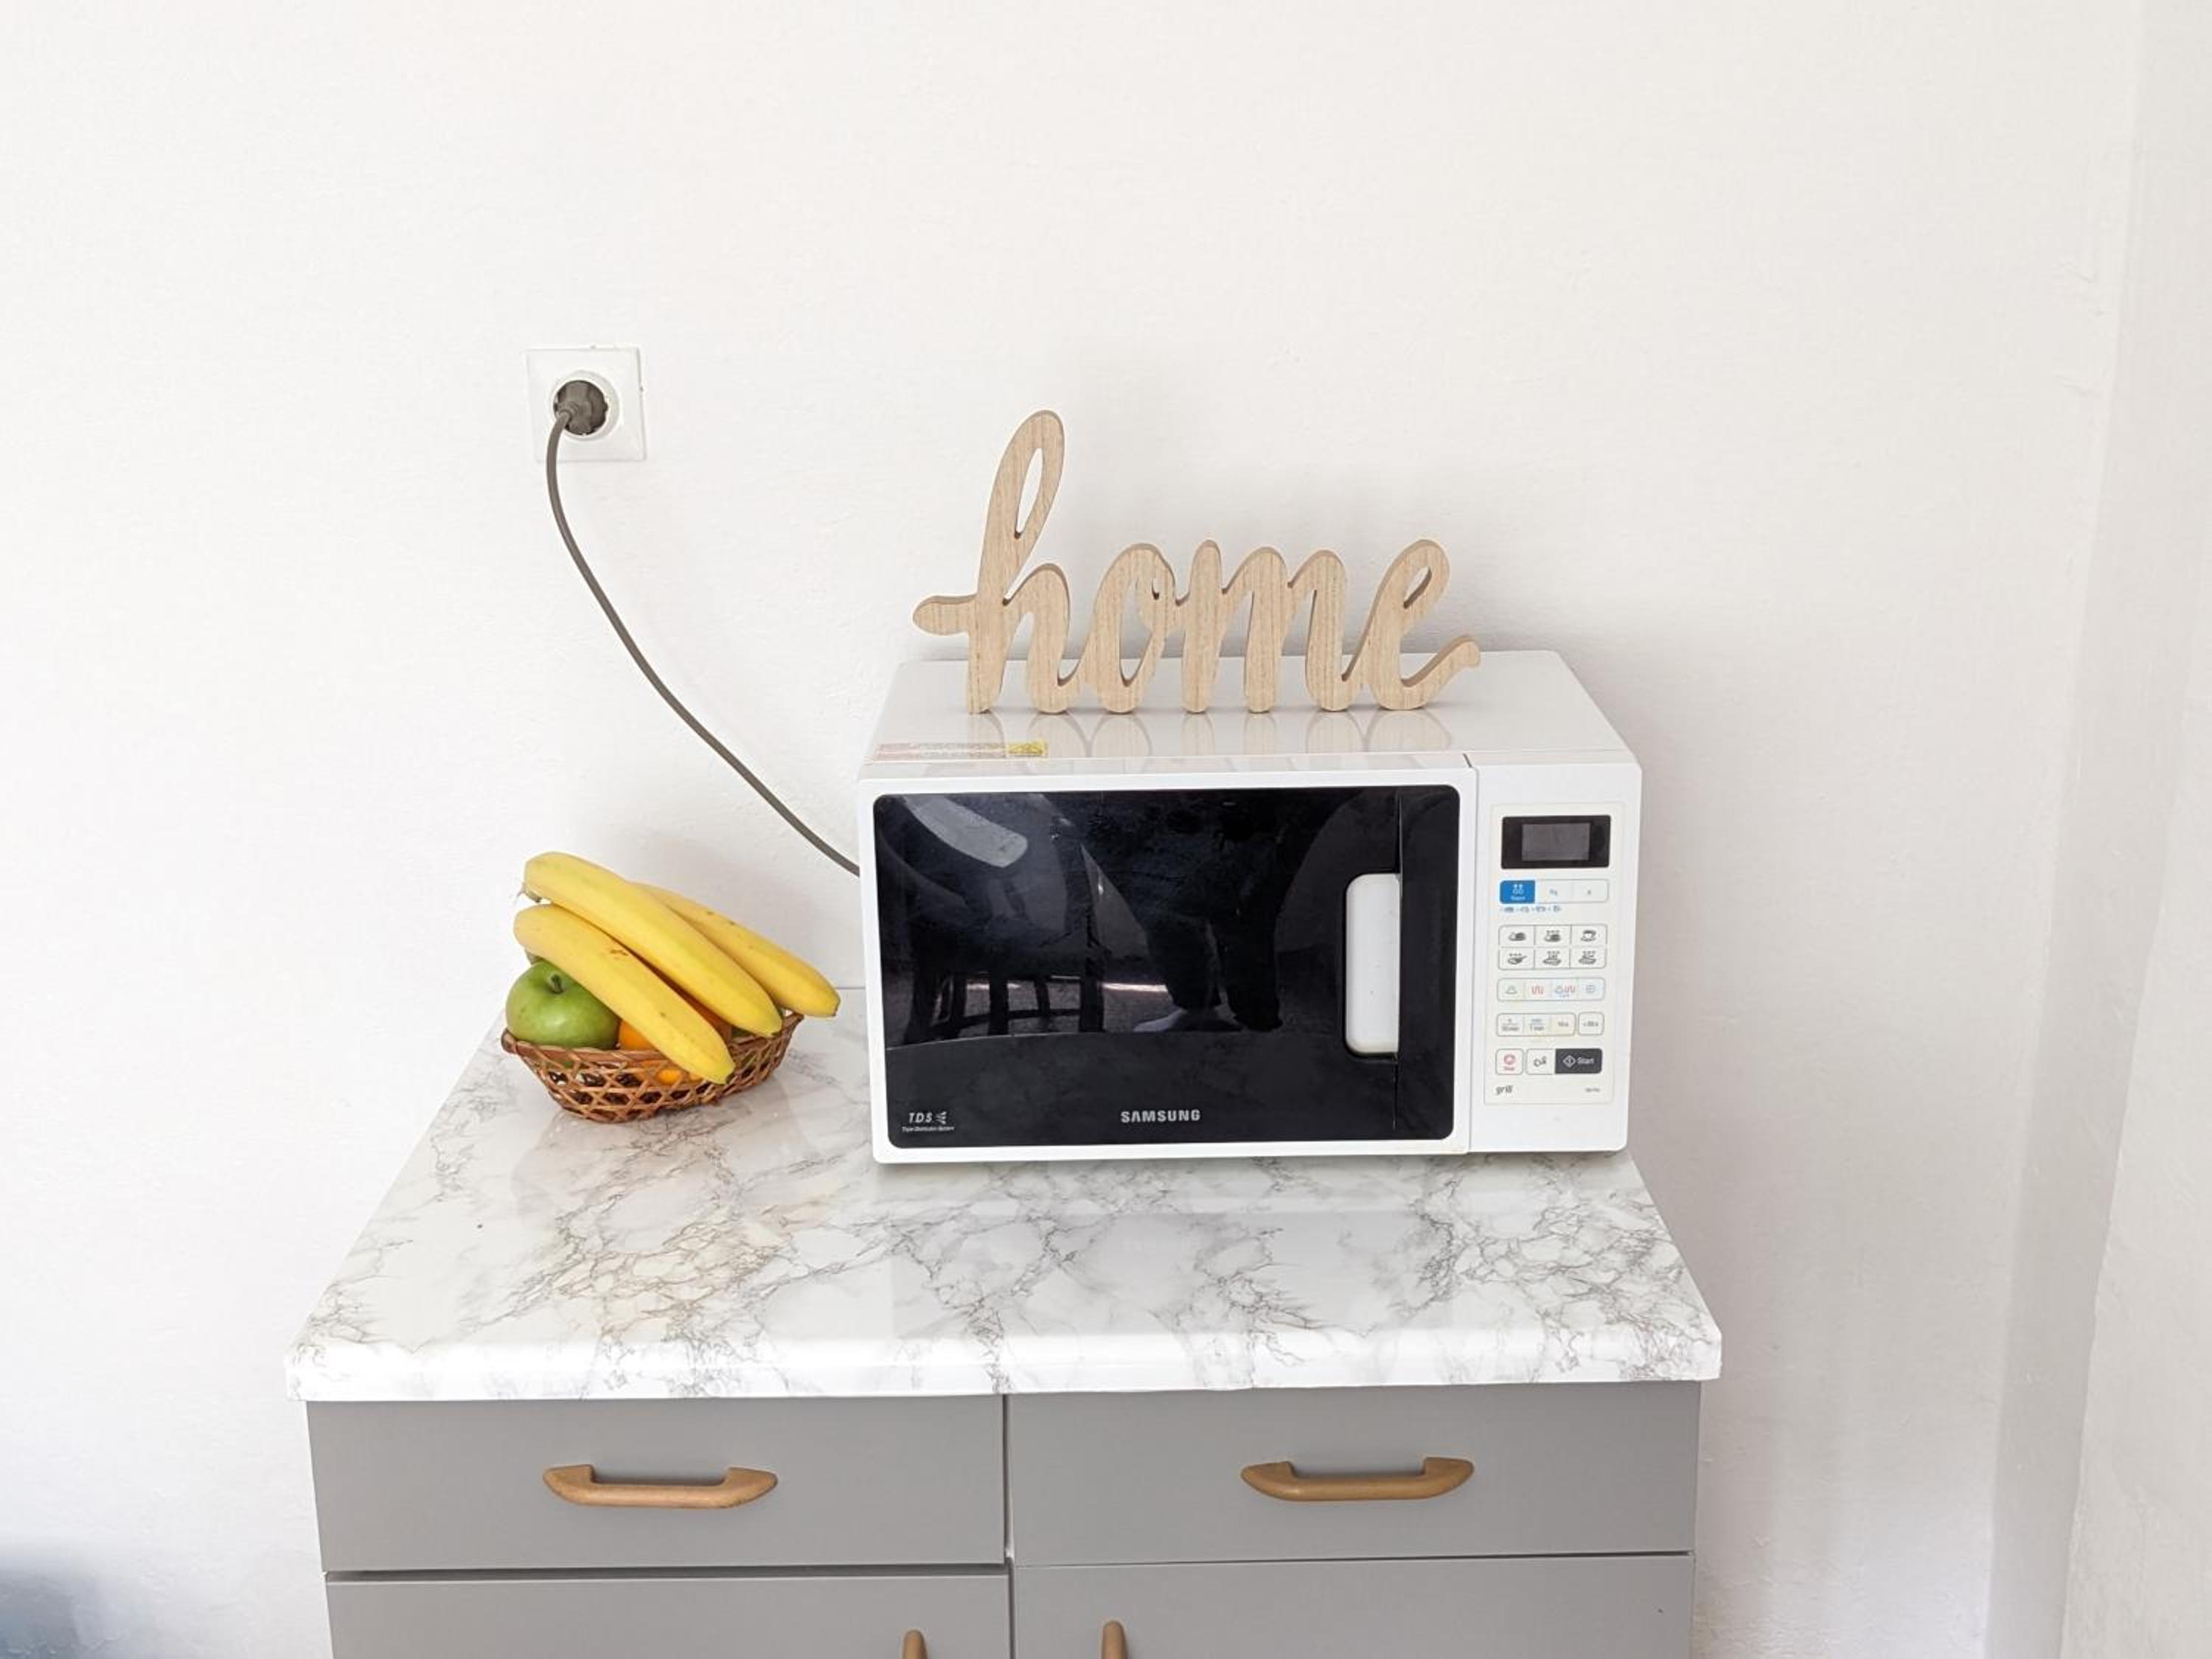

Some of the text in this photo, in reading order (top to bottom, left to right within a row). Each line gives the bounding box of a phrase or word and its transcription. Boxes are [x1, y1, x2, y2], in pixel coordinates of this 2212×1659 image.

[913, 410, 1481, 714] home
[1577, 1057, 1595, 1065] Start
[1495, 1085, 1514, 1096] grill
[1120, 1109, 1201, 1124] SAMSUNG
